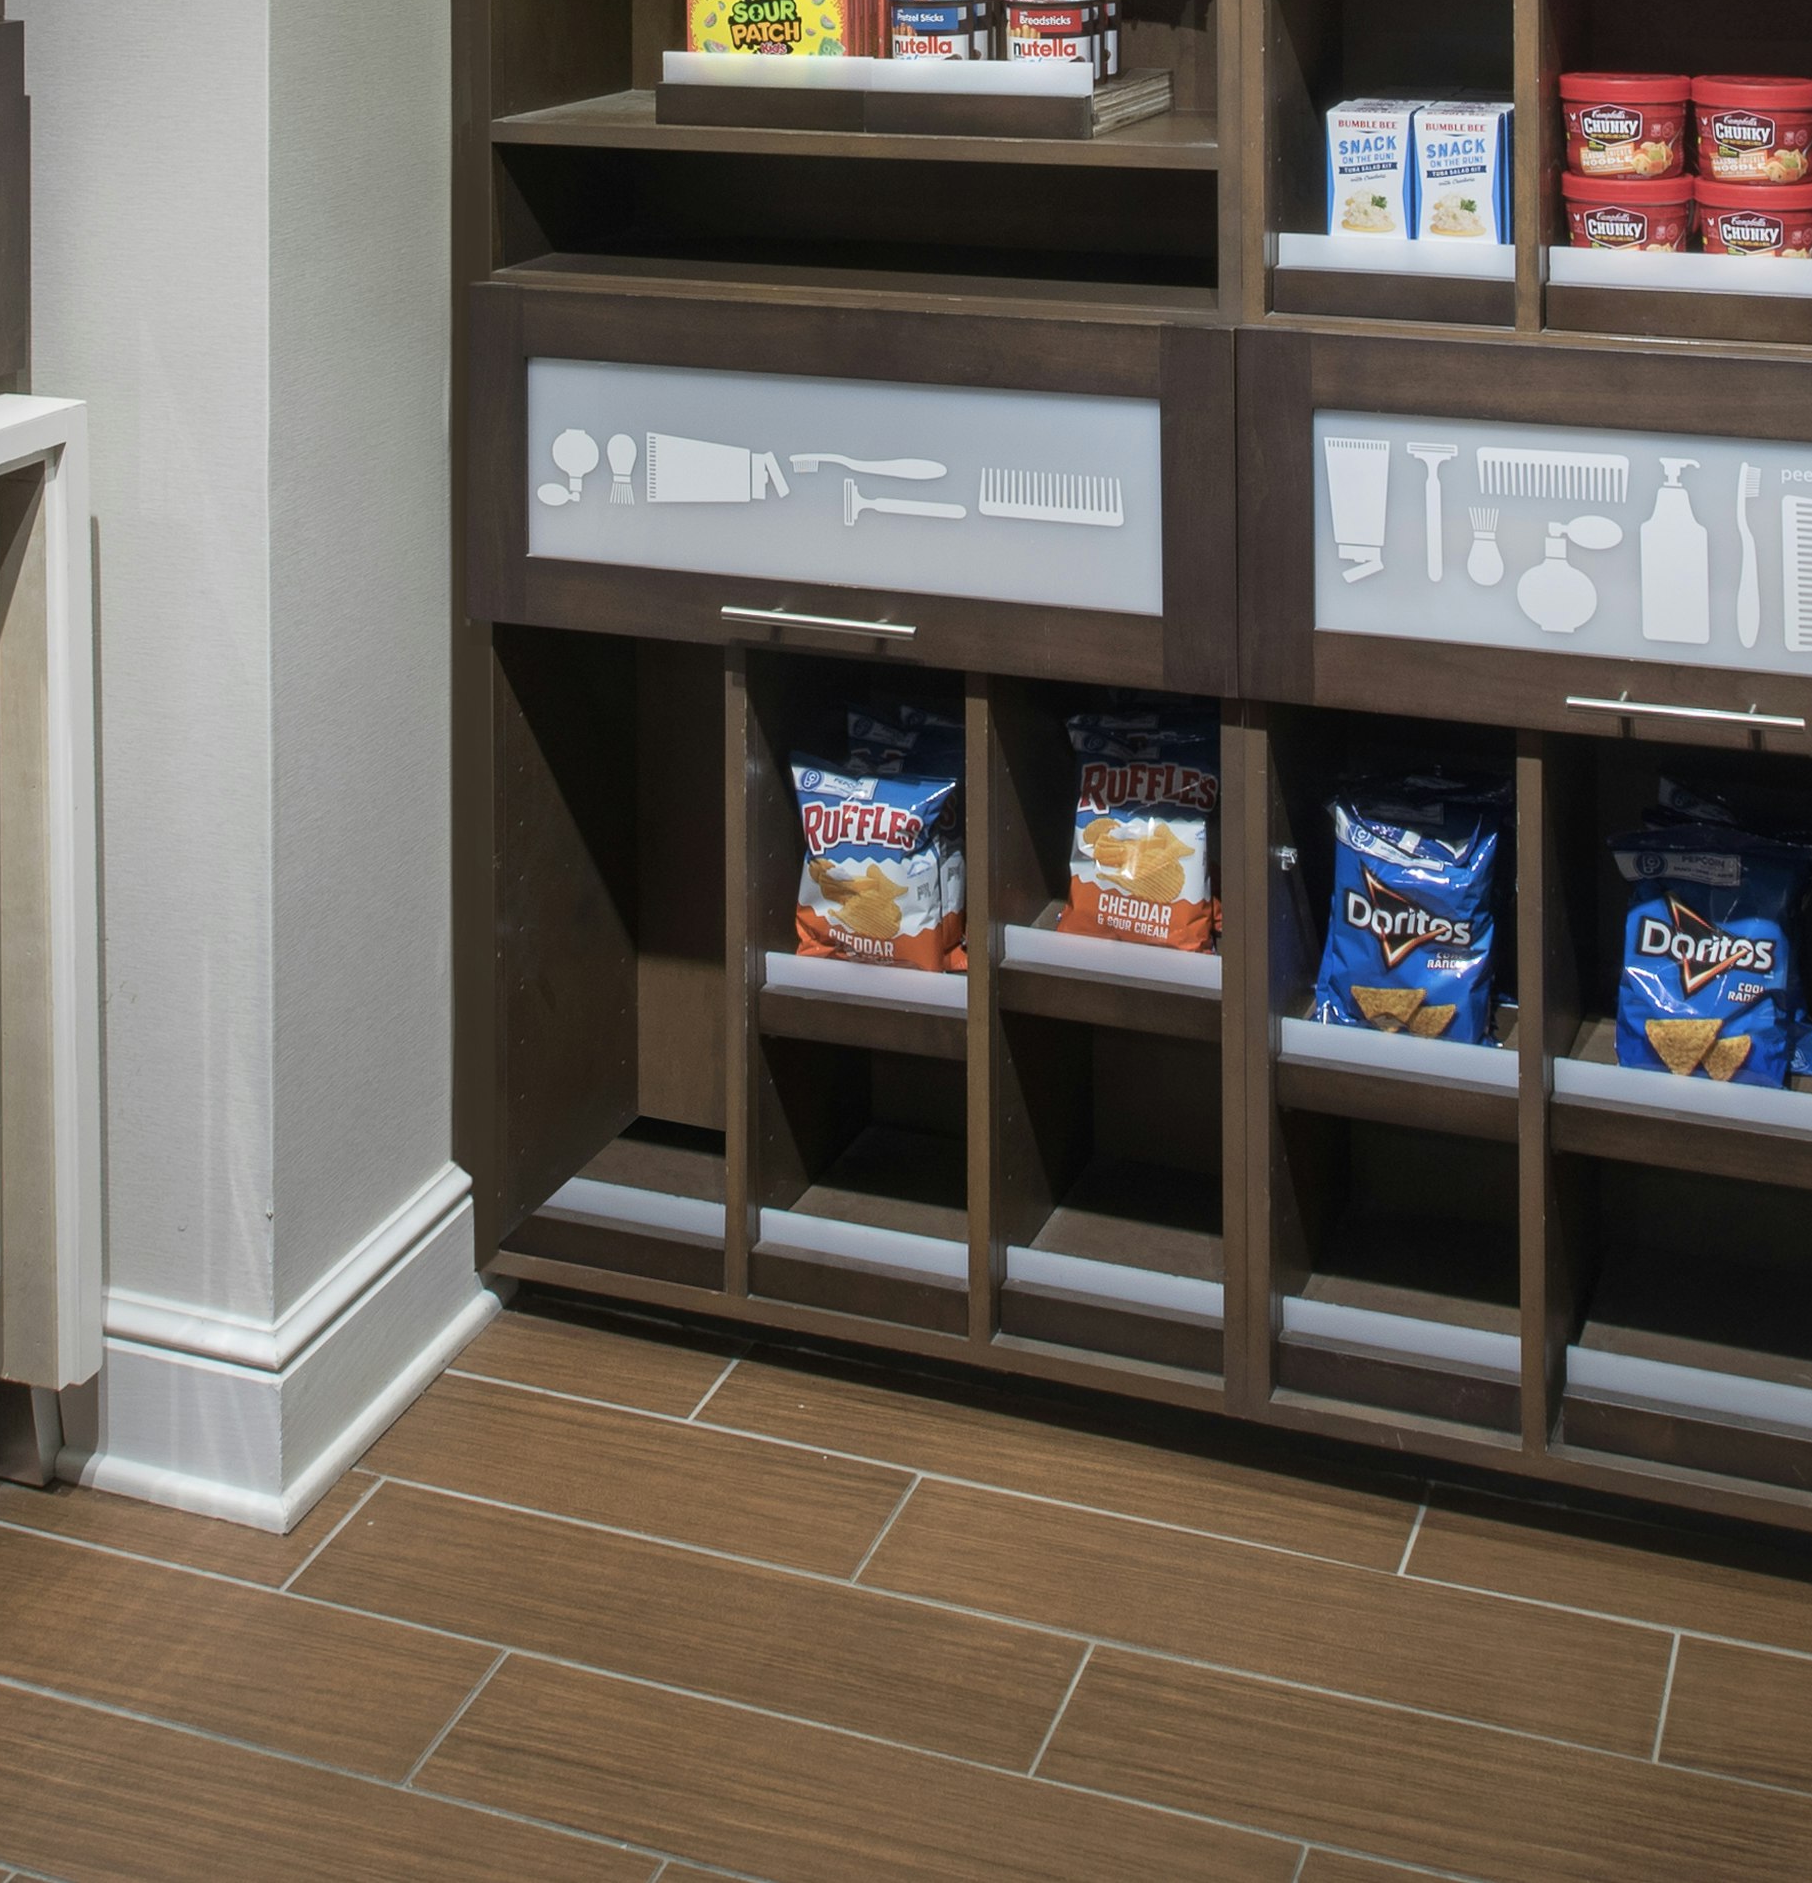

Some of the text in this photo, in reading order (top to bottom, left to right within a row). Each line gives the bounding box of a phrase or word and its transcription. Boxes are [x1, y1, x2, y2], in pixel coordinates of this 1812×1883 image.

[732, 0, 797, 23] SOUR
[1018, 15, 1072, 26] Breadsticks
[730, 21, 801, 46] PATCH
[894, 35, 953, 55] nutella
[1013, 38, 1077, 57] nutella
[1338, 119, 1398, 130] BUMBLE BEE
[1582, 117, 1639, 135] CHUNKY
[1715, 123, 1771, 142] CHUNKY
[1339, 135, 1397, 155] SNACK
[1427, 138, 1485, 158] SNACK
[1587, 219, 1644, 238] CHUNKY
[1721, 224, 1780, 244] CHUNKY
[1078, 763, 1218, 813] RUFFLES
[803, 802, 922, 854] RUFFLES
[1098, 893, 1172, 926] CHEDDAR
[1348, 891, 1471, 944] Doritos
[1133, 922, 1169, 940] CREAM
[828, 928, 895, 958] CHEDDAR
[1641, 919, 1773, 969] Doritos
